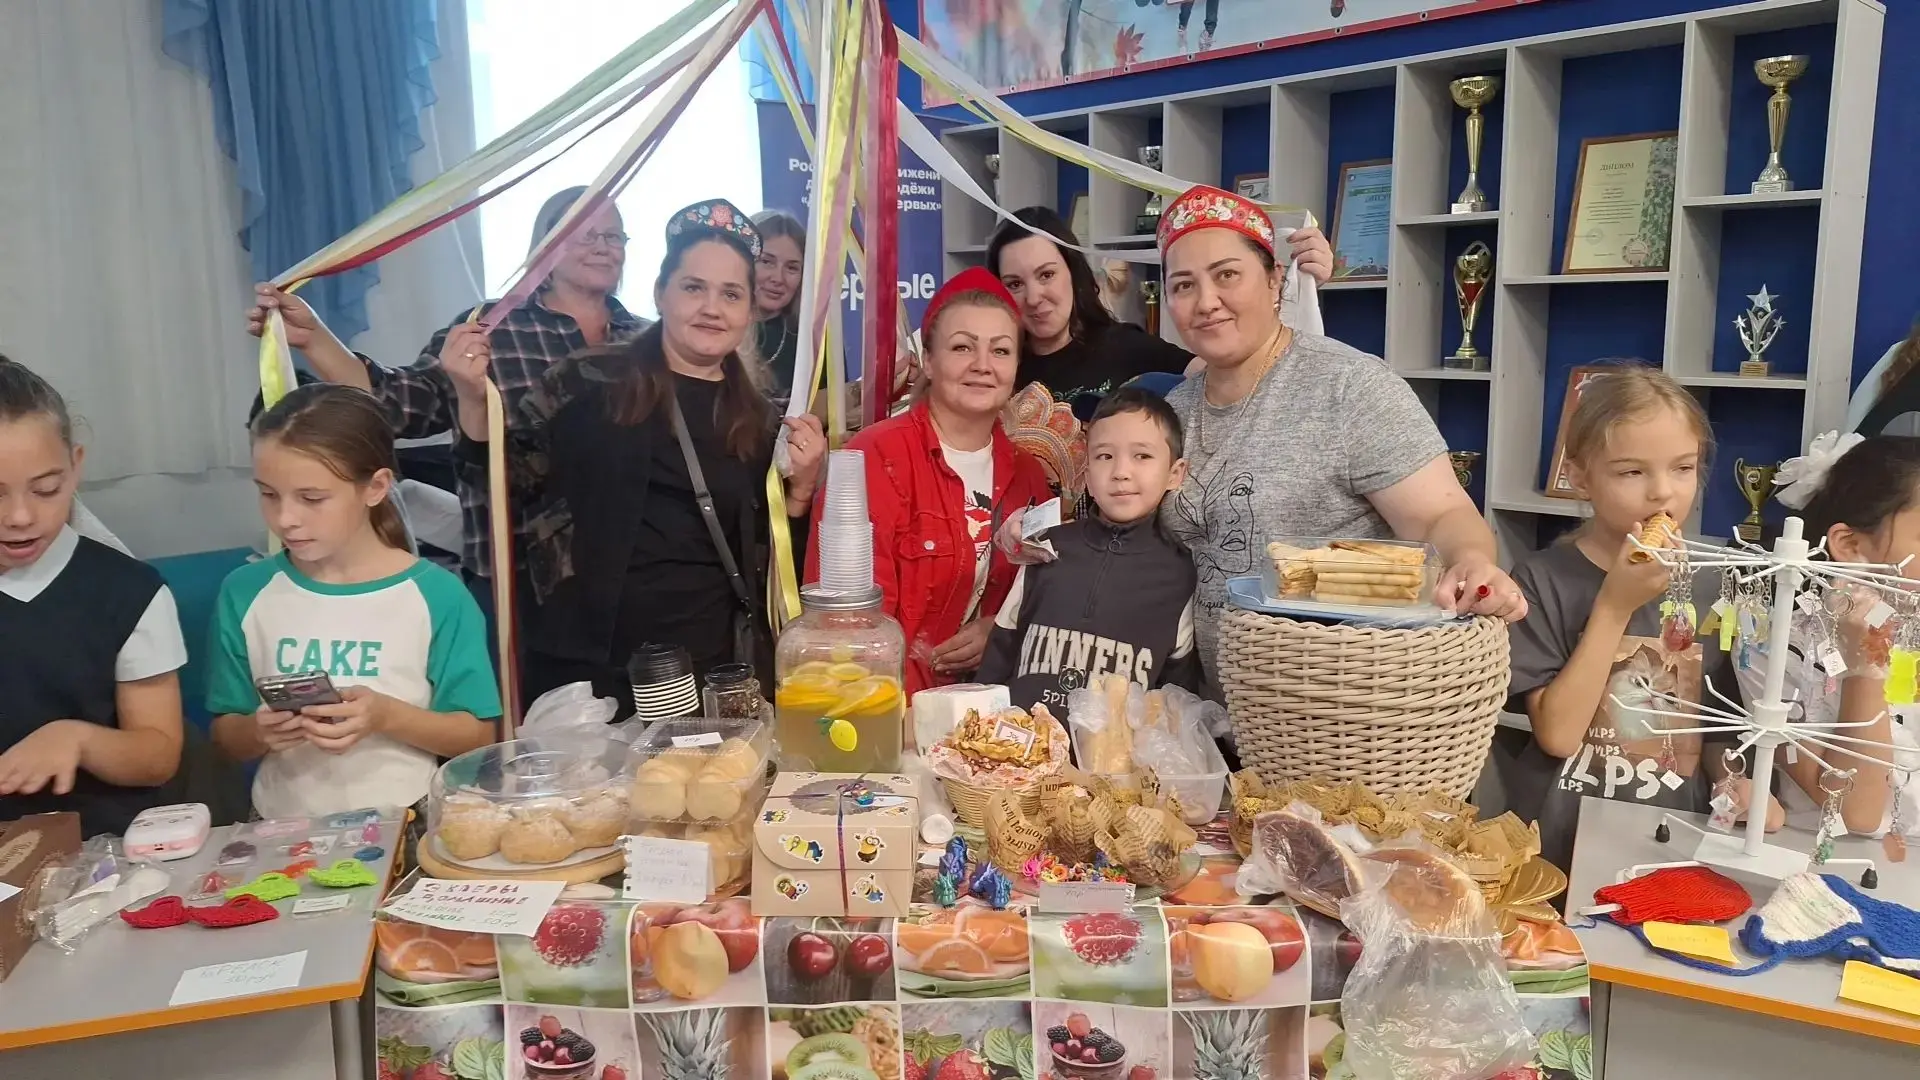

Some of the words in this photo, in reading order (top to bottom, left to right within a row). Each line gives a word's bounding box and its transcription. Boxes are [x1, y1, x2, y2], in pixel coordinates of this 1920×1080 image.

[276, 637, 383, 677] CAKE
[1017, 623, 1153, 693] WINNERS
[1588, 727, 1616, 739] VLPS
[1594, 744, 1621, 757] VLPS
